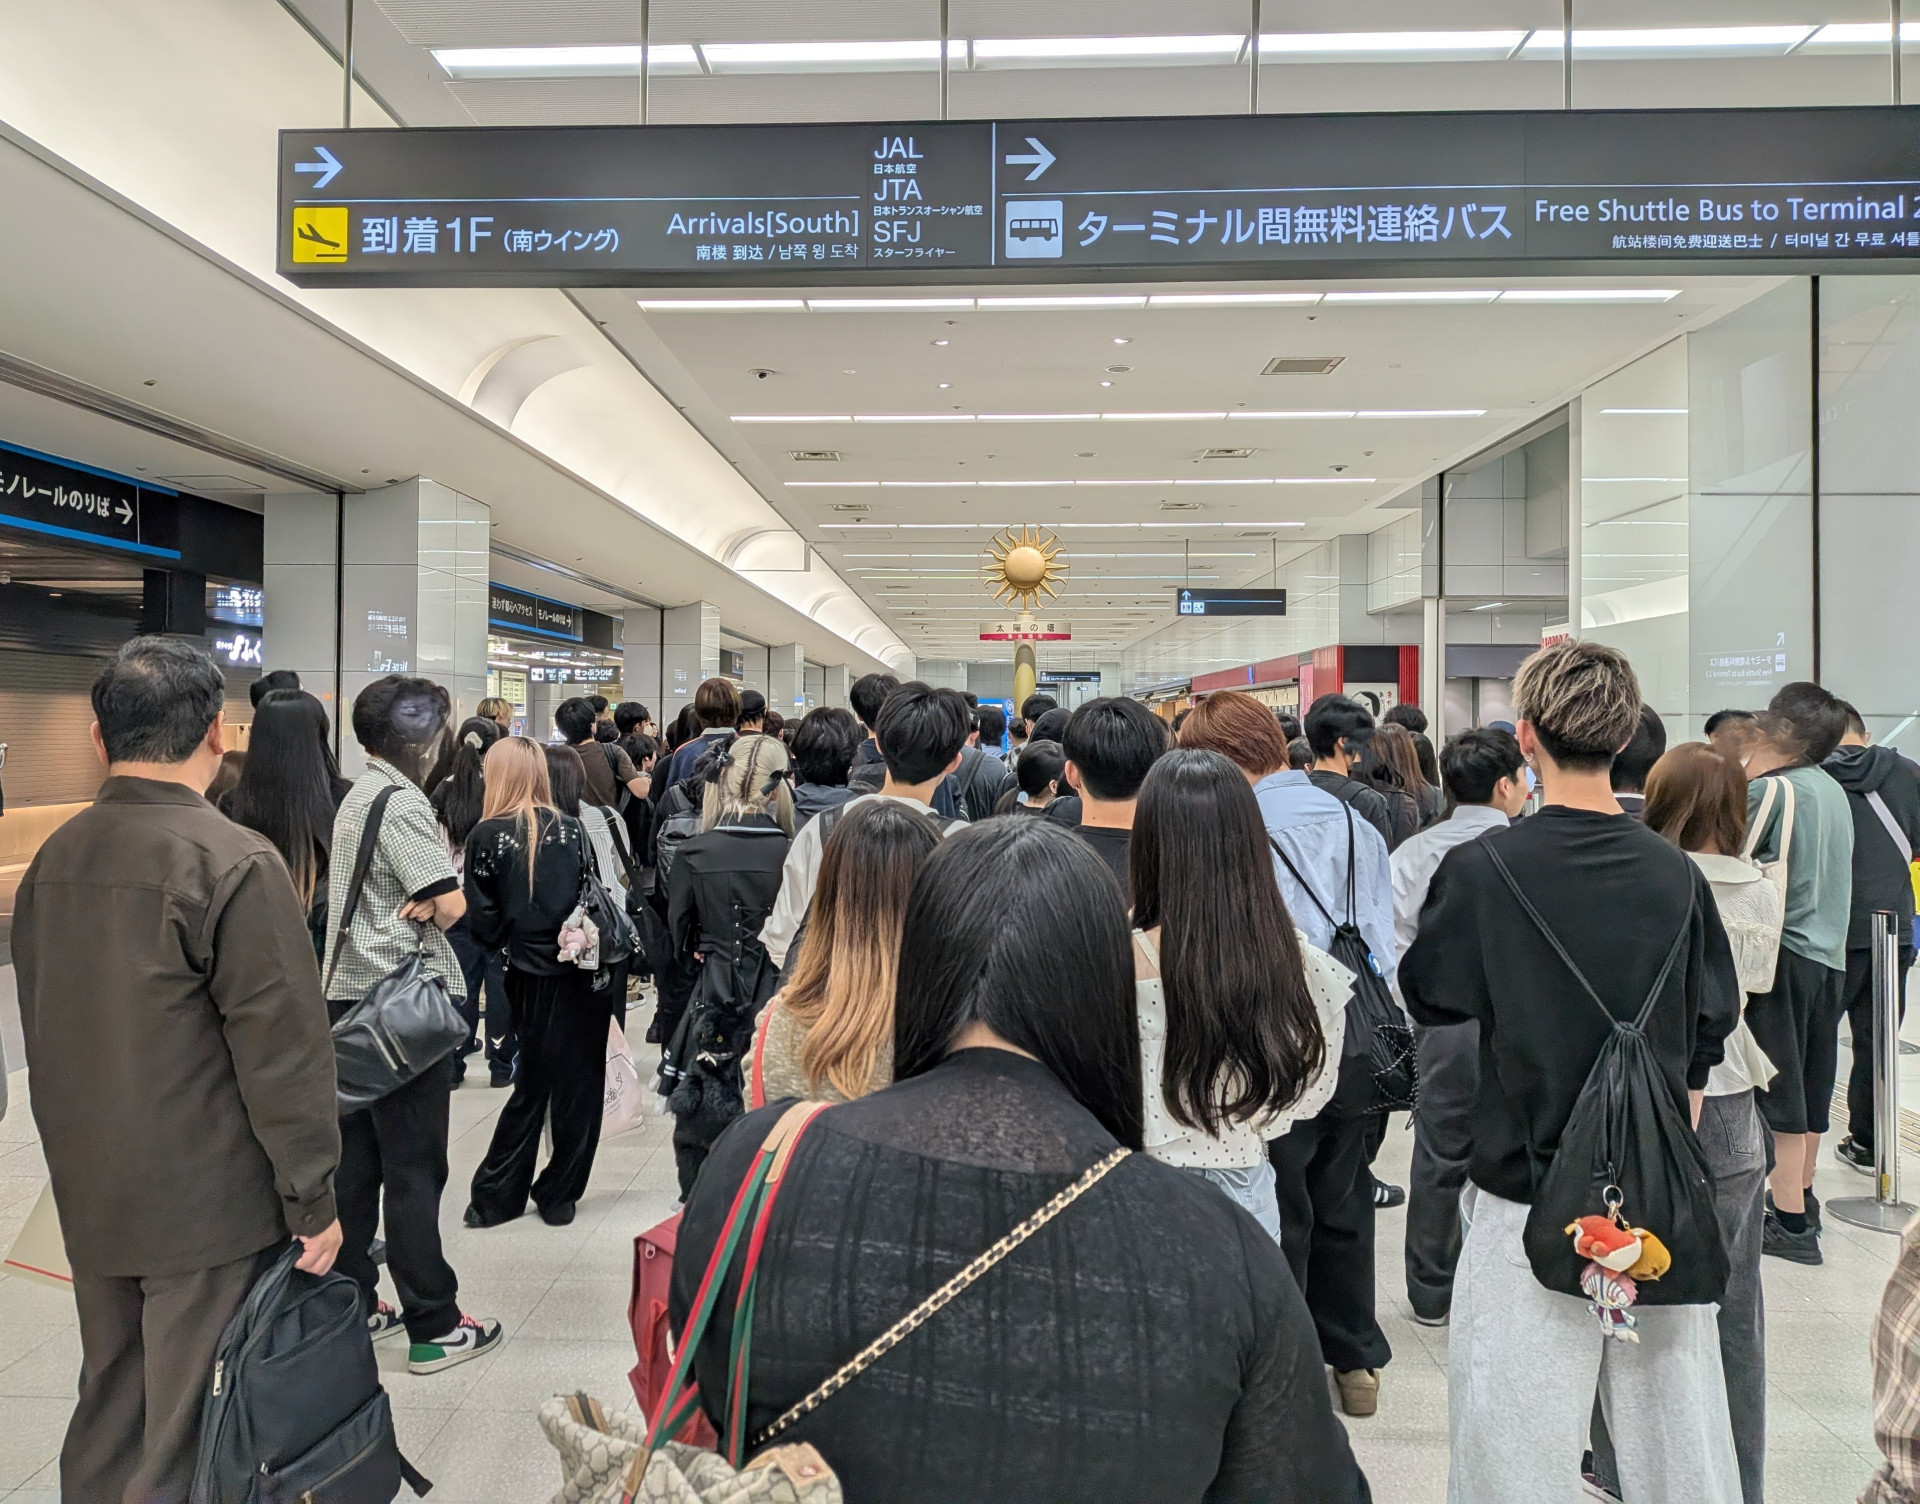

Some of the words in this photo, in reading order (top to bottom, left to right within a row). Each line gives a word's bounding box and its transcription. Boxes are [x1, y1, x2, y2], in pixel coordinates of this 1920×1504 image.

[874, 136, 924, 159] JAL
[873, 163, 917, 174] 日本航空
[873, 179, 922, 201] JTA
[873, 205, 984, 216] 日本トランスオーシャン航空
[1535, 199, 1590, 222] Free
[1598, 198, 1690, 222] Shuttle
[1699, 198, 1743, 221] Bus
[1751, 200, 1779, 221] to
[1787, 195, 1904, 220] Terminal
[667, 209, 859, 237] Arrivals[South]
[873, 220, 921, 243] SFJ
[1077, 202, 1514, 246] ターミナル間無料連絡バス
[1612, 234, 1763, 249] 航站楼间免费迎送巴士
[1784, 232, 1829, 248] 터미널
[1834, 232, 1849, 248] 간
[1854, 232, 1885, 247] 무료
[830, 243, 858, 260] 도착
[874, 248, 956, 258] スターフライヤー
[996, 623, 1055, 633] 太陽の塔
[574, 668, 613, 676] きっぷうりば
